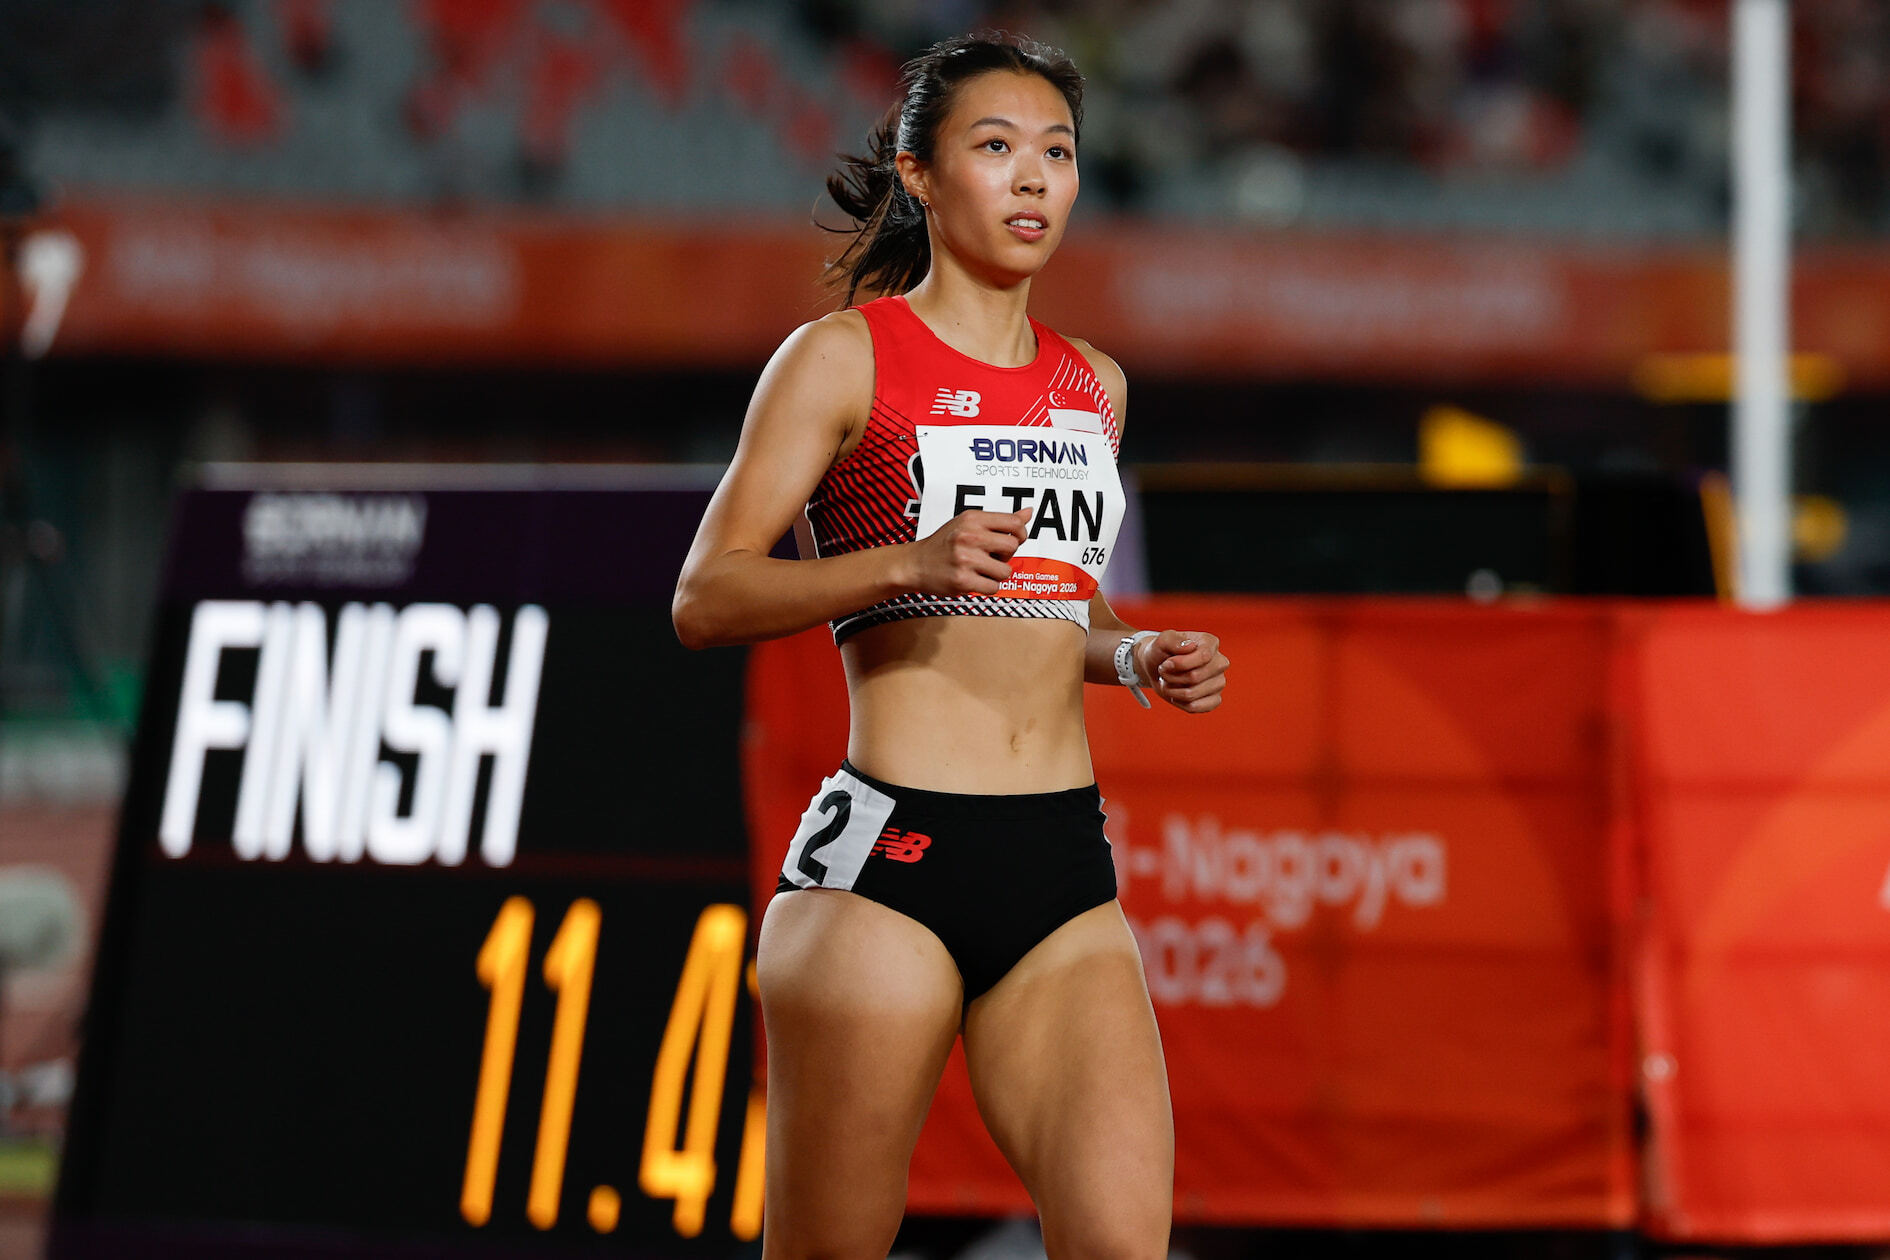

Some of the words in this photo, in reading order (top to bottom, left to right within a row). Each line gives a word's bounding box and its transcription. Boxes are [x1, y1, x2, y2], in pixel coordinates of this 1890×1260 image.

[969, 438, 1088, 466] BORNAN
[976, 465, 1020, 477] SPORTS
[1025, 466, 1089, 481] TECHNOLOGY
[1001, 486, 1104, 542] TAN
[1082, 547, 1105, 566] 676
[999, 580, 1058, 595] ichi-Nagoya
[1059, 583, 1077, 593] 2026
[1012, 571, 1034, 580] Asian
[1035, 573, 1059, 581] Games
[158, 600, 550, 867] FINISH
[797, 790, 852, 886] 2
